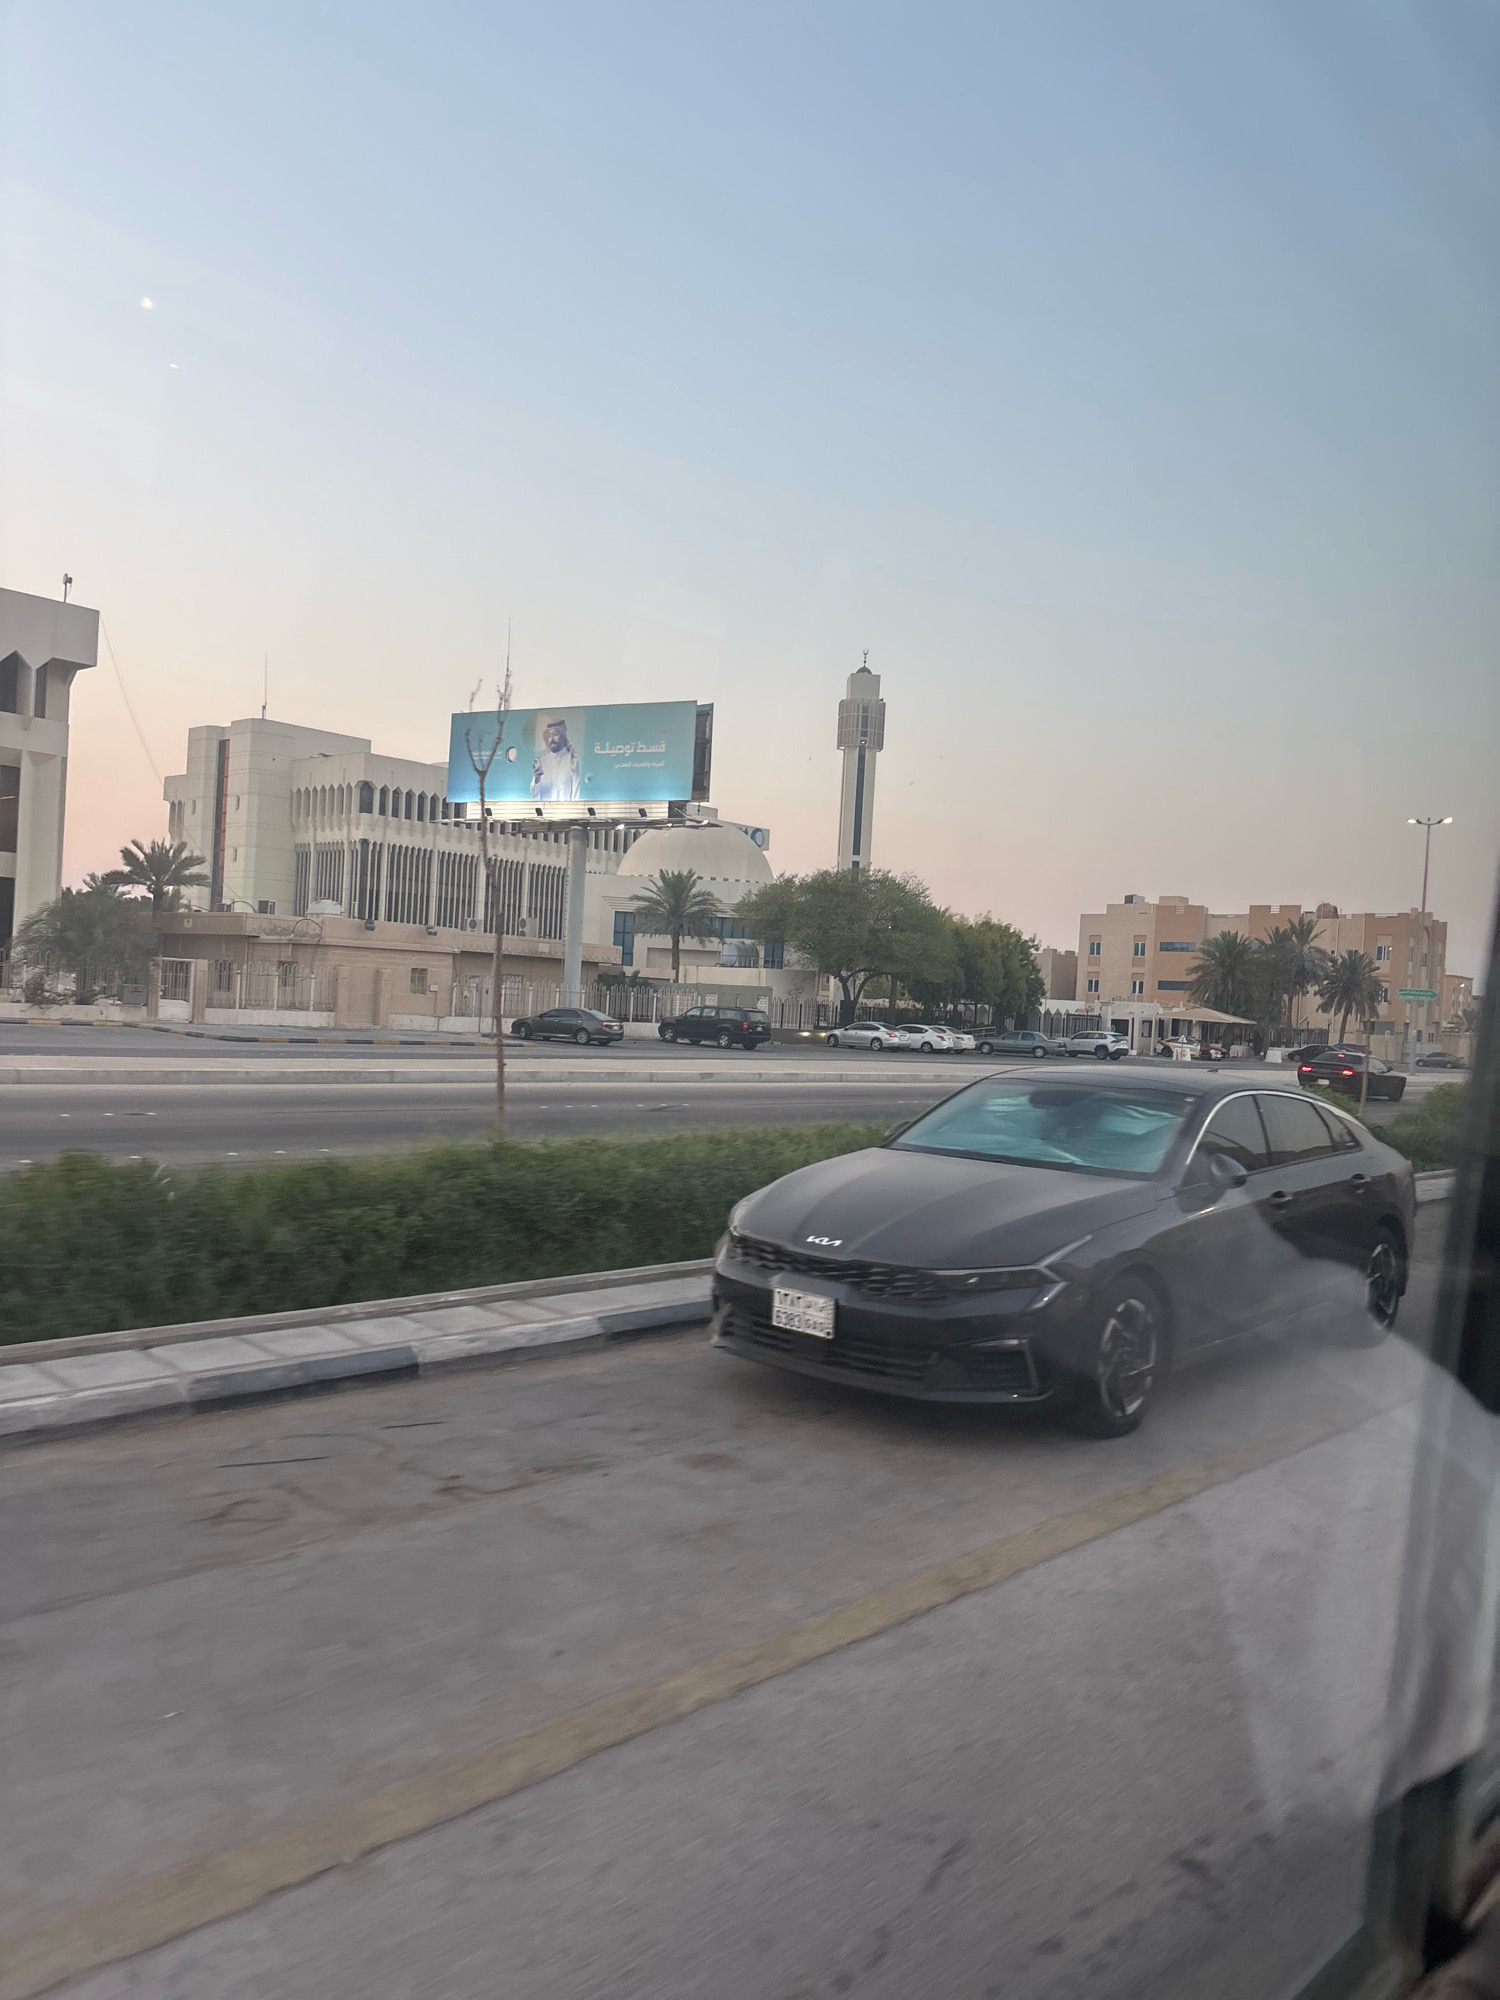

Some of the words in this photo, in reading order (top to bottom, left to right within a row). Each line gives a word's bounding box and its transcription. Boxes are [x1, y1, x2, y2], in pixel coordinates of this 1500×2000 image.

[594, 741, 636, 757] توصيلة
[636, 741, 666, 753] قسط
[806, 1235, 843, 1247] KIA
